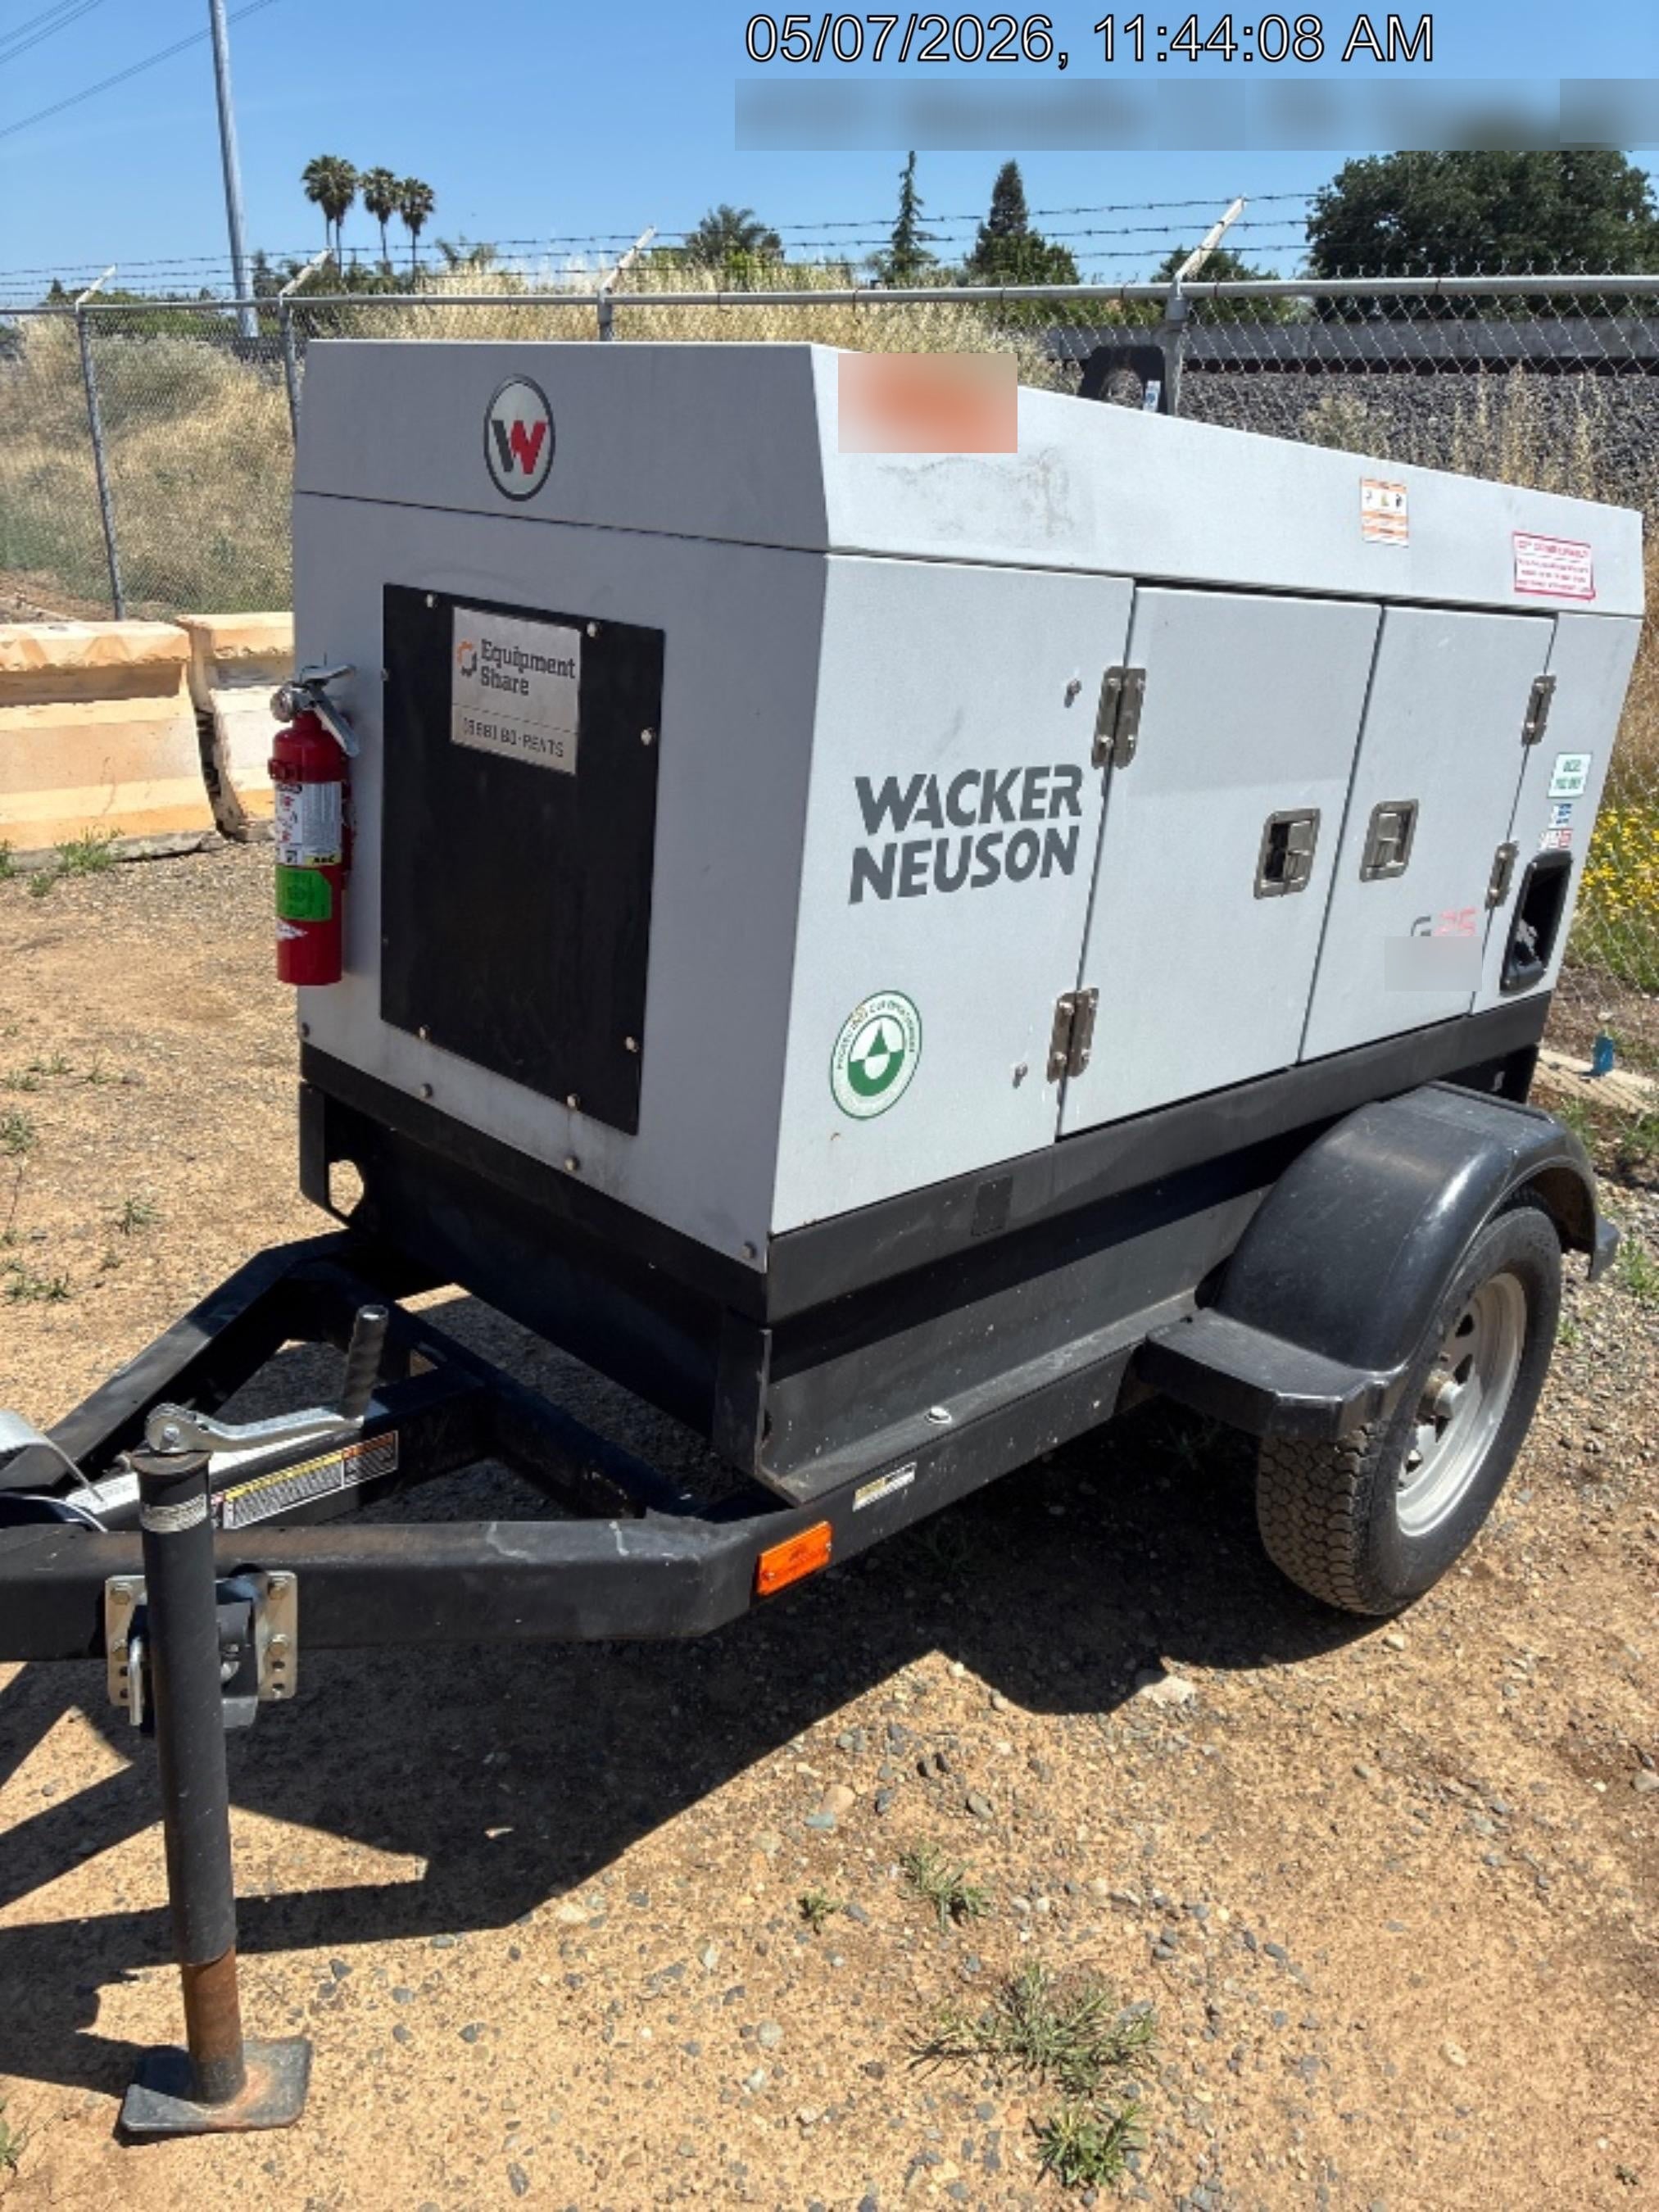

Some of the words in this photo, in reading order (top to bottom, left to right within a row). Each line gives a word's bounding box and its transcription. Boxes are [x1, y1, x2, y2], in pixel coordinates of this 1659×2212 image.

[481, 638, 575, 679] Equipment
[481, 665, 529, 696] Share
[854, 764, 1083, 836] WACKER
[849, 825, 1080, 904] NEUSON
